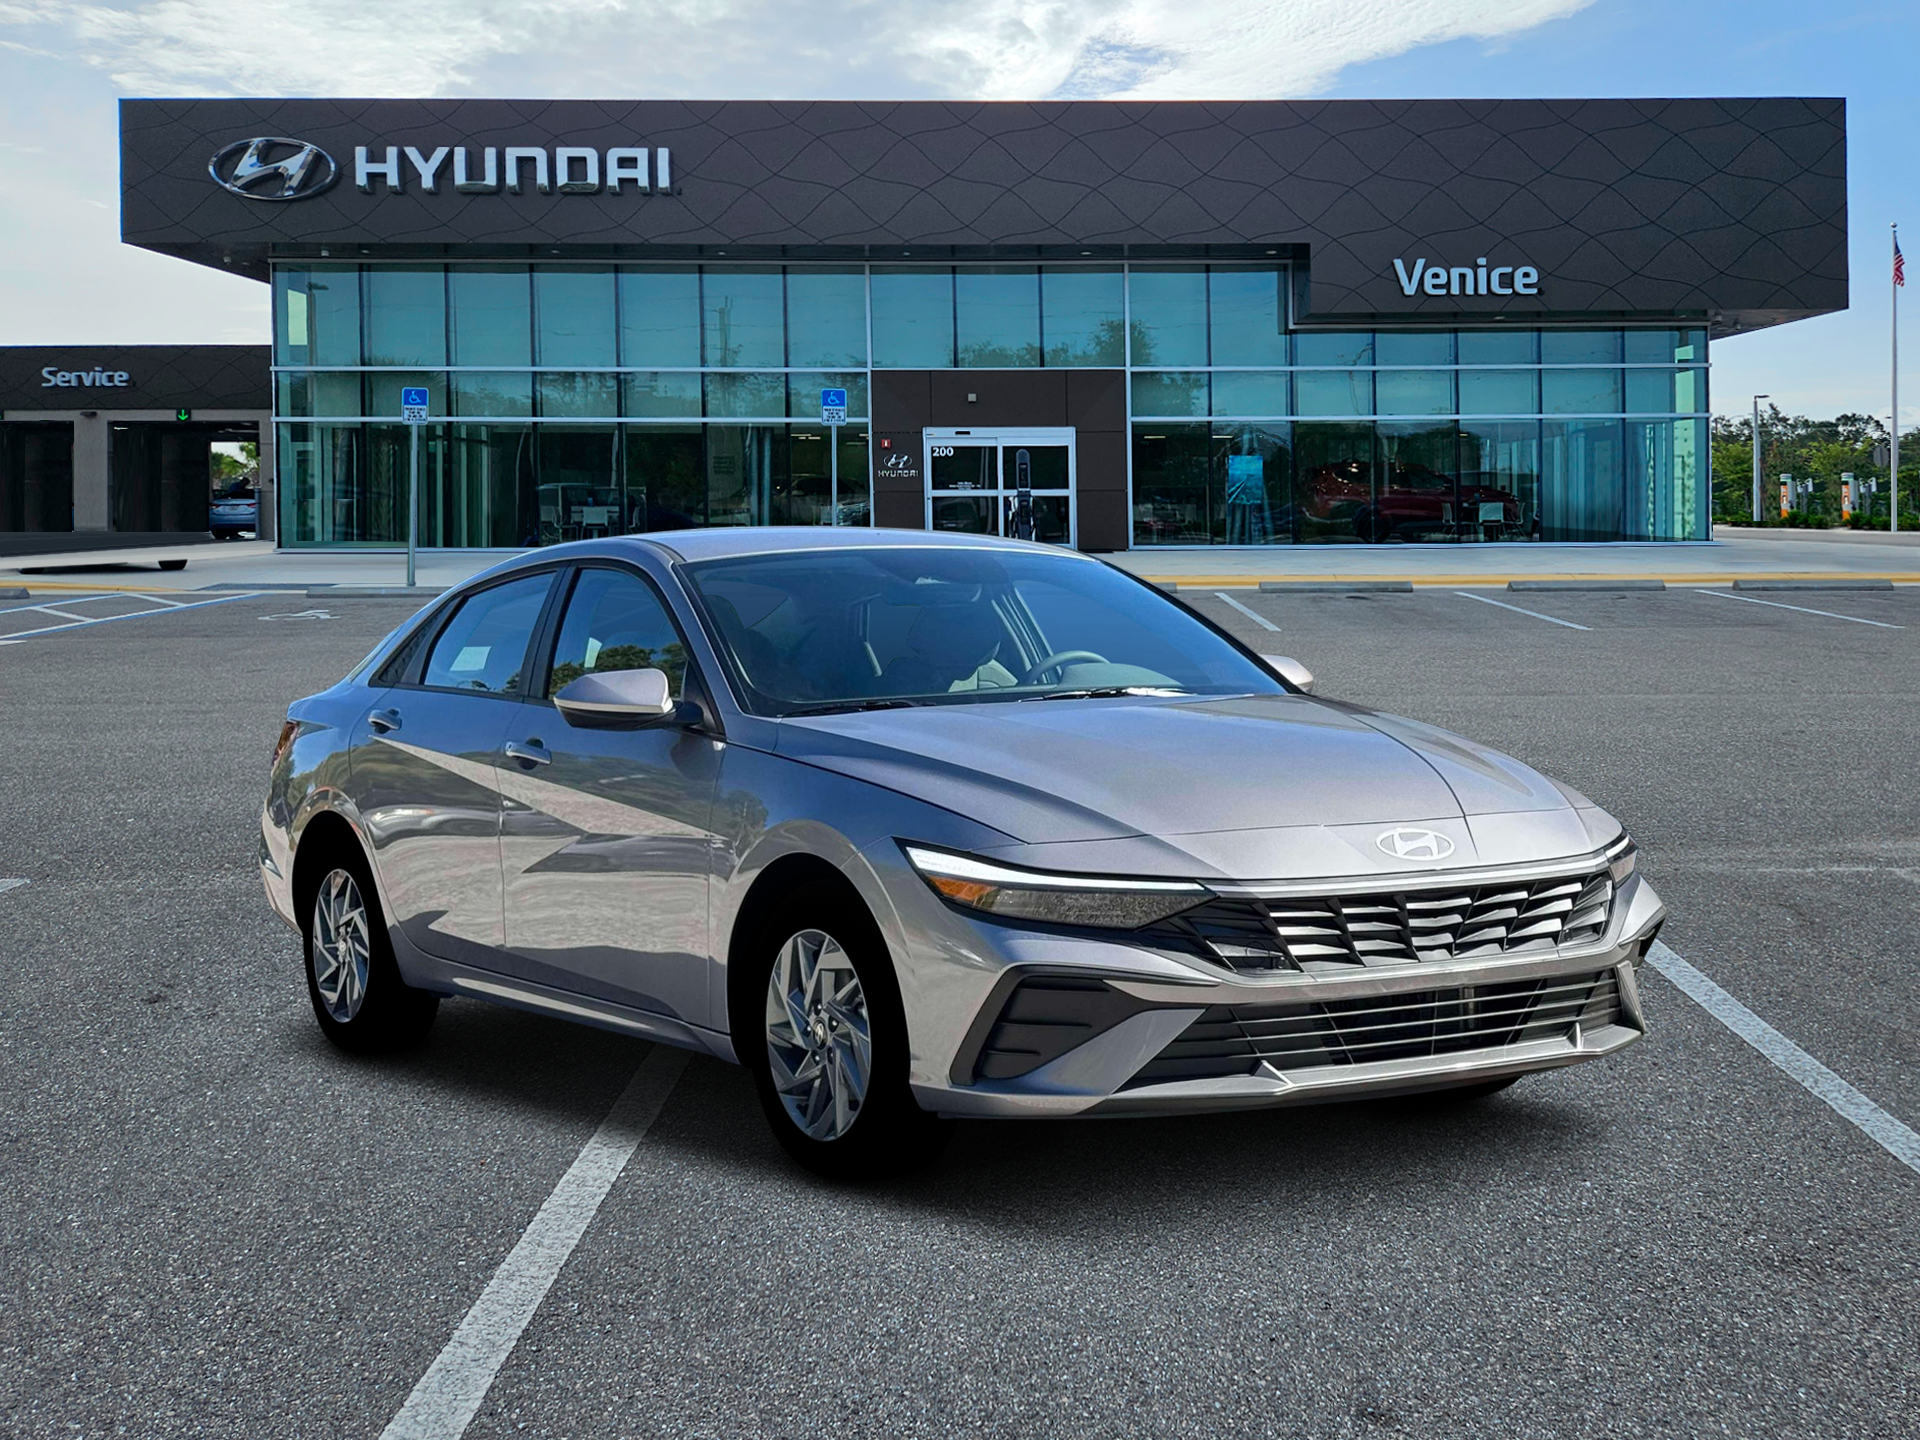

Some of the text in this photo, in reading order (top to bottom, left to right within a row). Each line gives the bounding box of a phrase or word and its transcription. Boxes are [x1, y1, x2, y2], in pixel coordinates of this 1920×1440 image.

[354, 146, 671, 194] HYUNDAI
[1392, 256, 1540, 296] Venice
[41, 366, 130, 388] Service
[932, 446, 954, 457] 200
[877, 469, 919, 478] HYUNDAI
